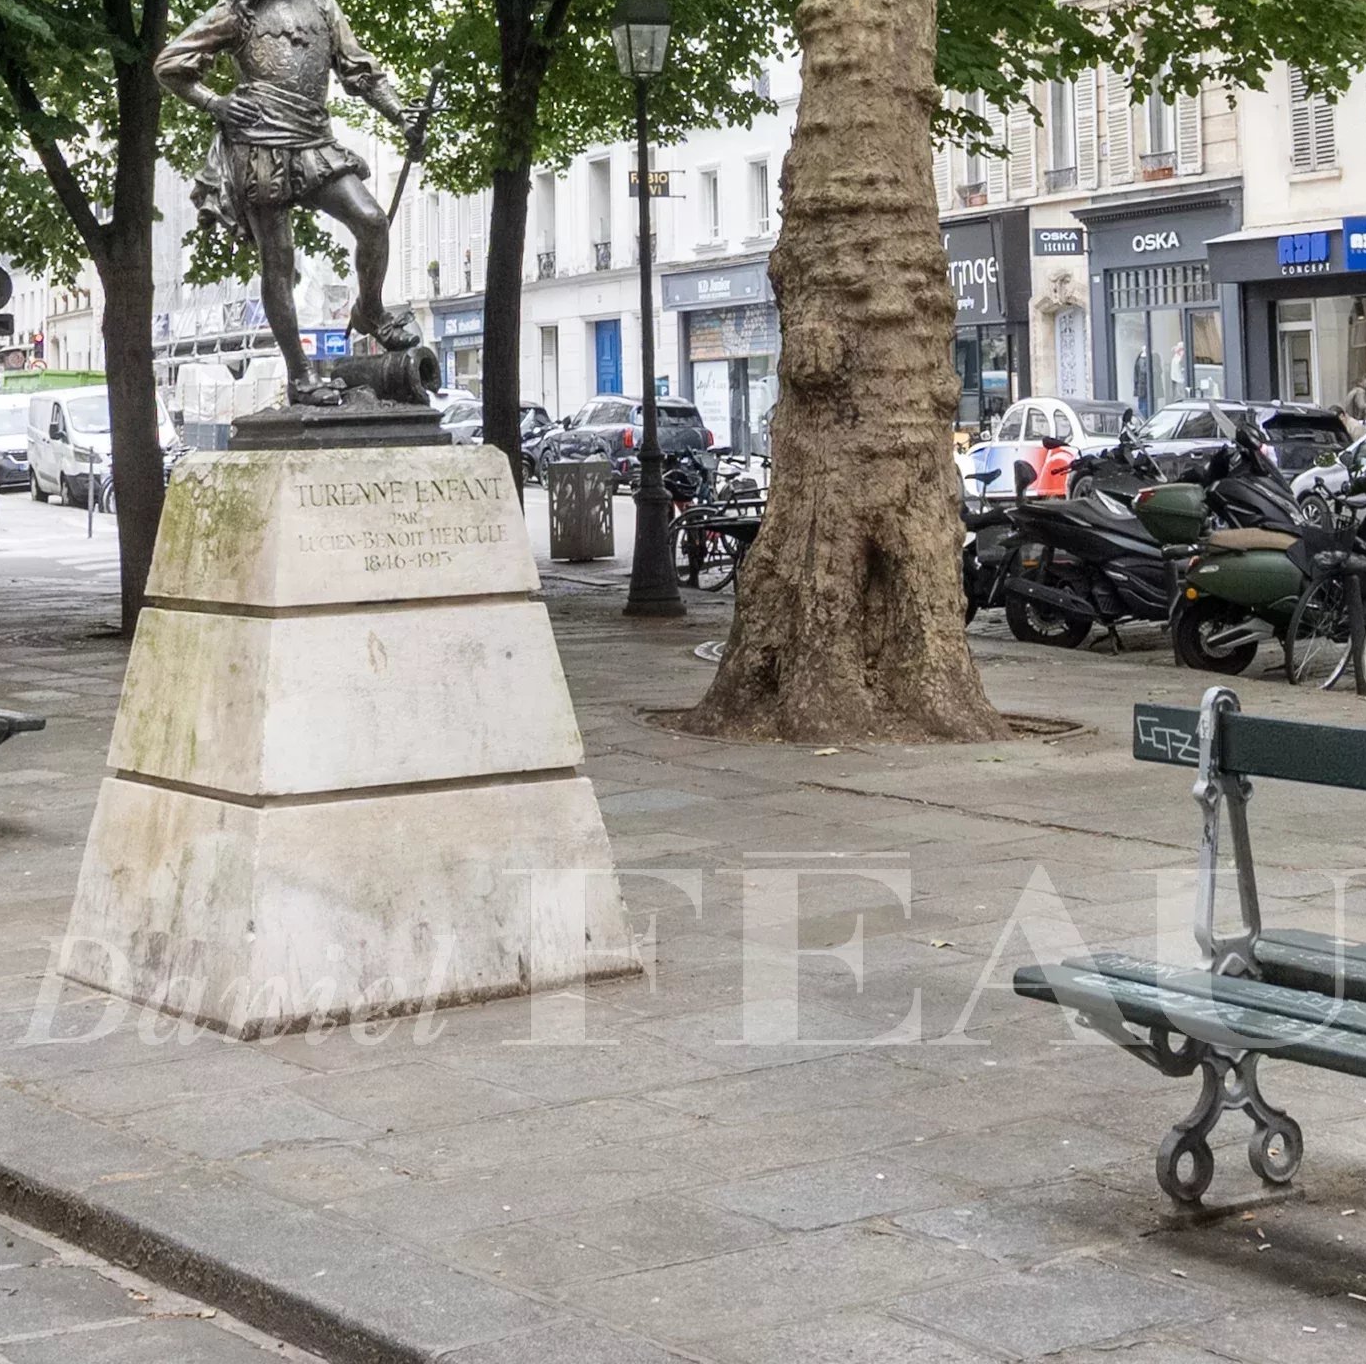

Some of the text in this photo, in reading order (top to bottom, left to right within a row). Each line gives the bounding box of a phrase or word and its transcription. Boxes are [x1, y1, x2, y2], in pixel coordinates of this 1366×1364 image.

[1040, 231, 1078, 241] OSKA
[1132, 231, 1180, 253] OSKA
[1281, 263, 1331, 276] CONCEPT
[296, 477, 502, 508] TURENNE ENFANT
[393, 512, 418, 525] PAR
[430, 523, 508, 545] HERCULE
